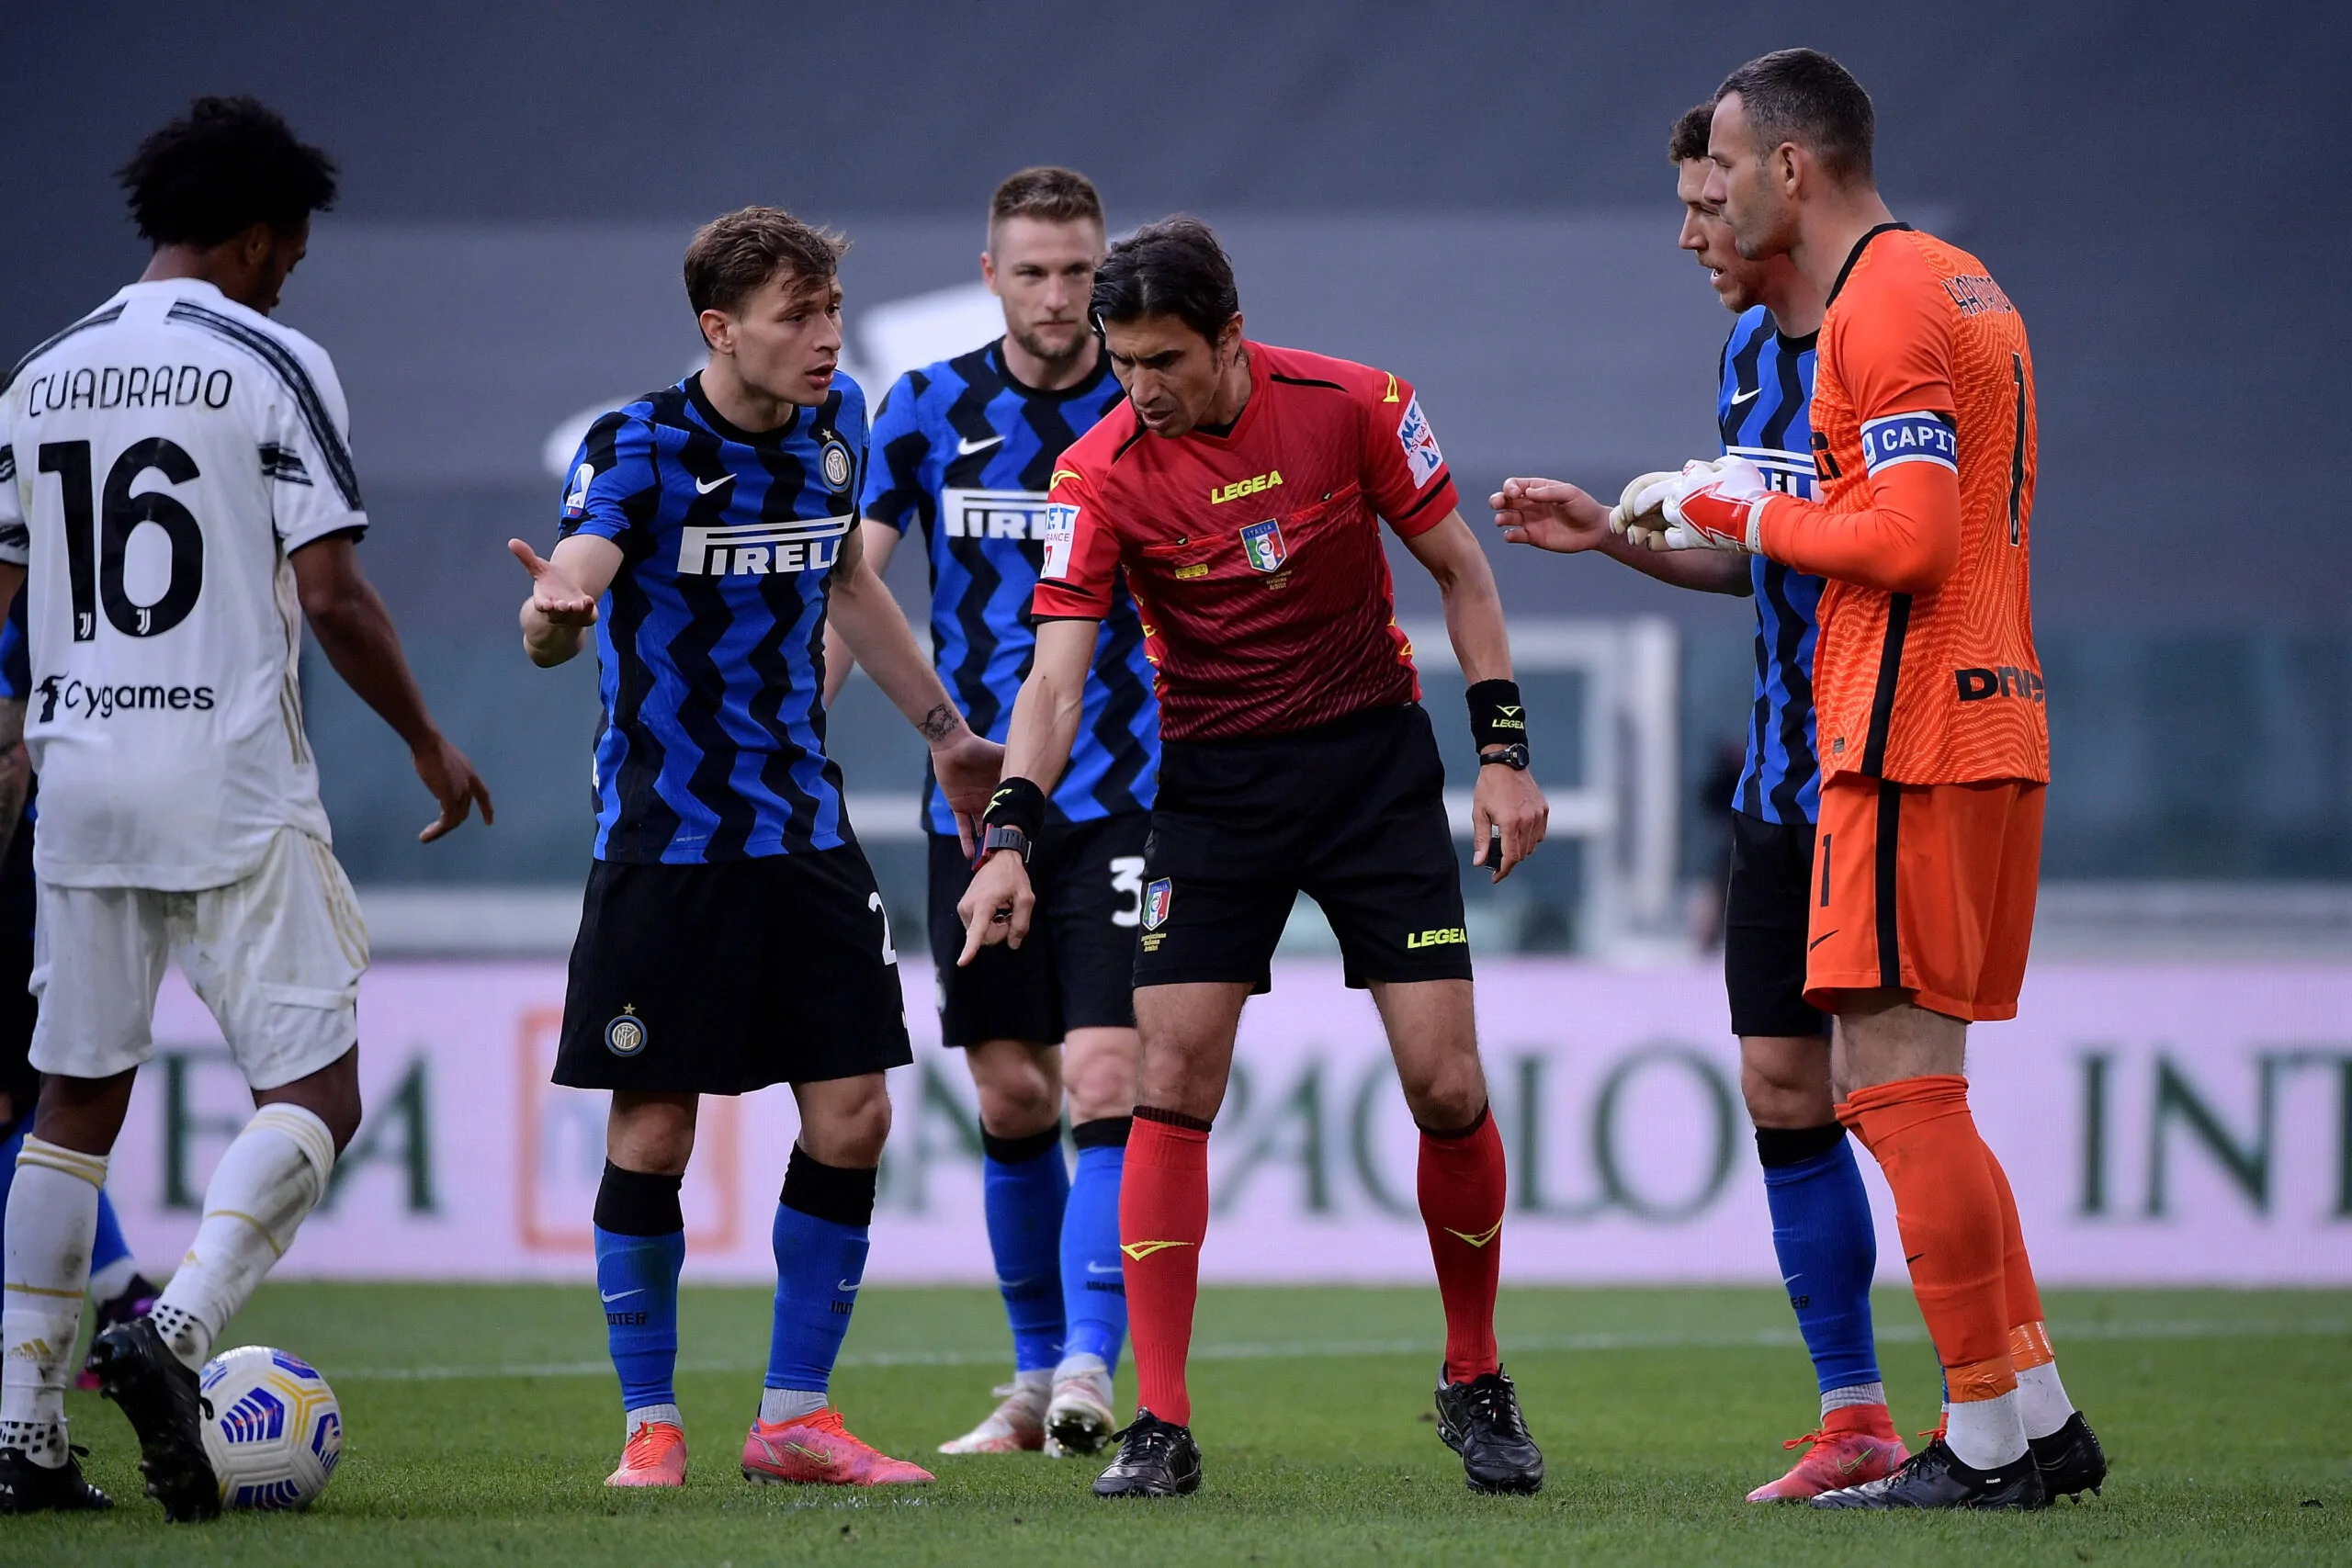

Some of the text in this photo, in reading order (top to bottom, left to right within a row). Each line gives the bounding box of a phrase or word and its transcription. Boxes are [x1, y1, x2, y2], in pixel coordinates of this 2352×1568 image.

[28, 366, 233, 418] CUADRADO
[2010, 351, 2027, 547] 1
[1211, 469, 1283, 505] LEGEA
[38, 436, 204, 643] 16
[1247, 524, 1272, 537] ITALIA
[64, 680, 215, 719] Cygames
[1491, 718, 1525, 731] LEGEA
[1820, 833, 1832, 908] 1
[1407, 928, 1467, 949] LEGEA
[606, 1312, 648, 1326] NTER
